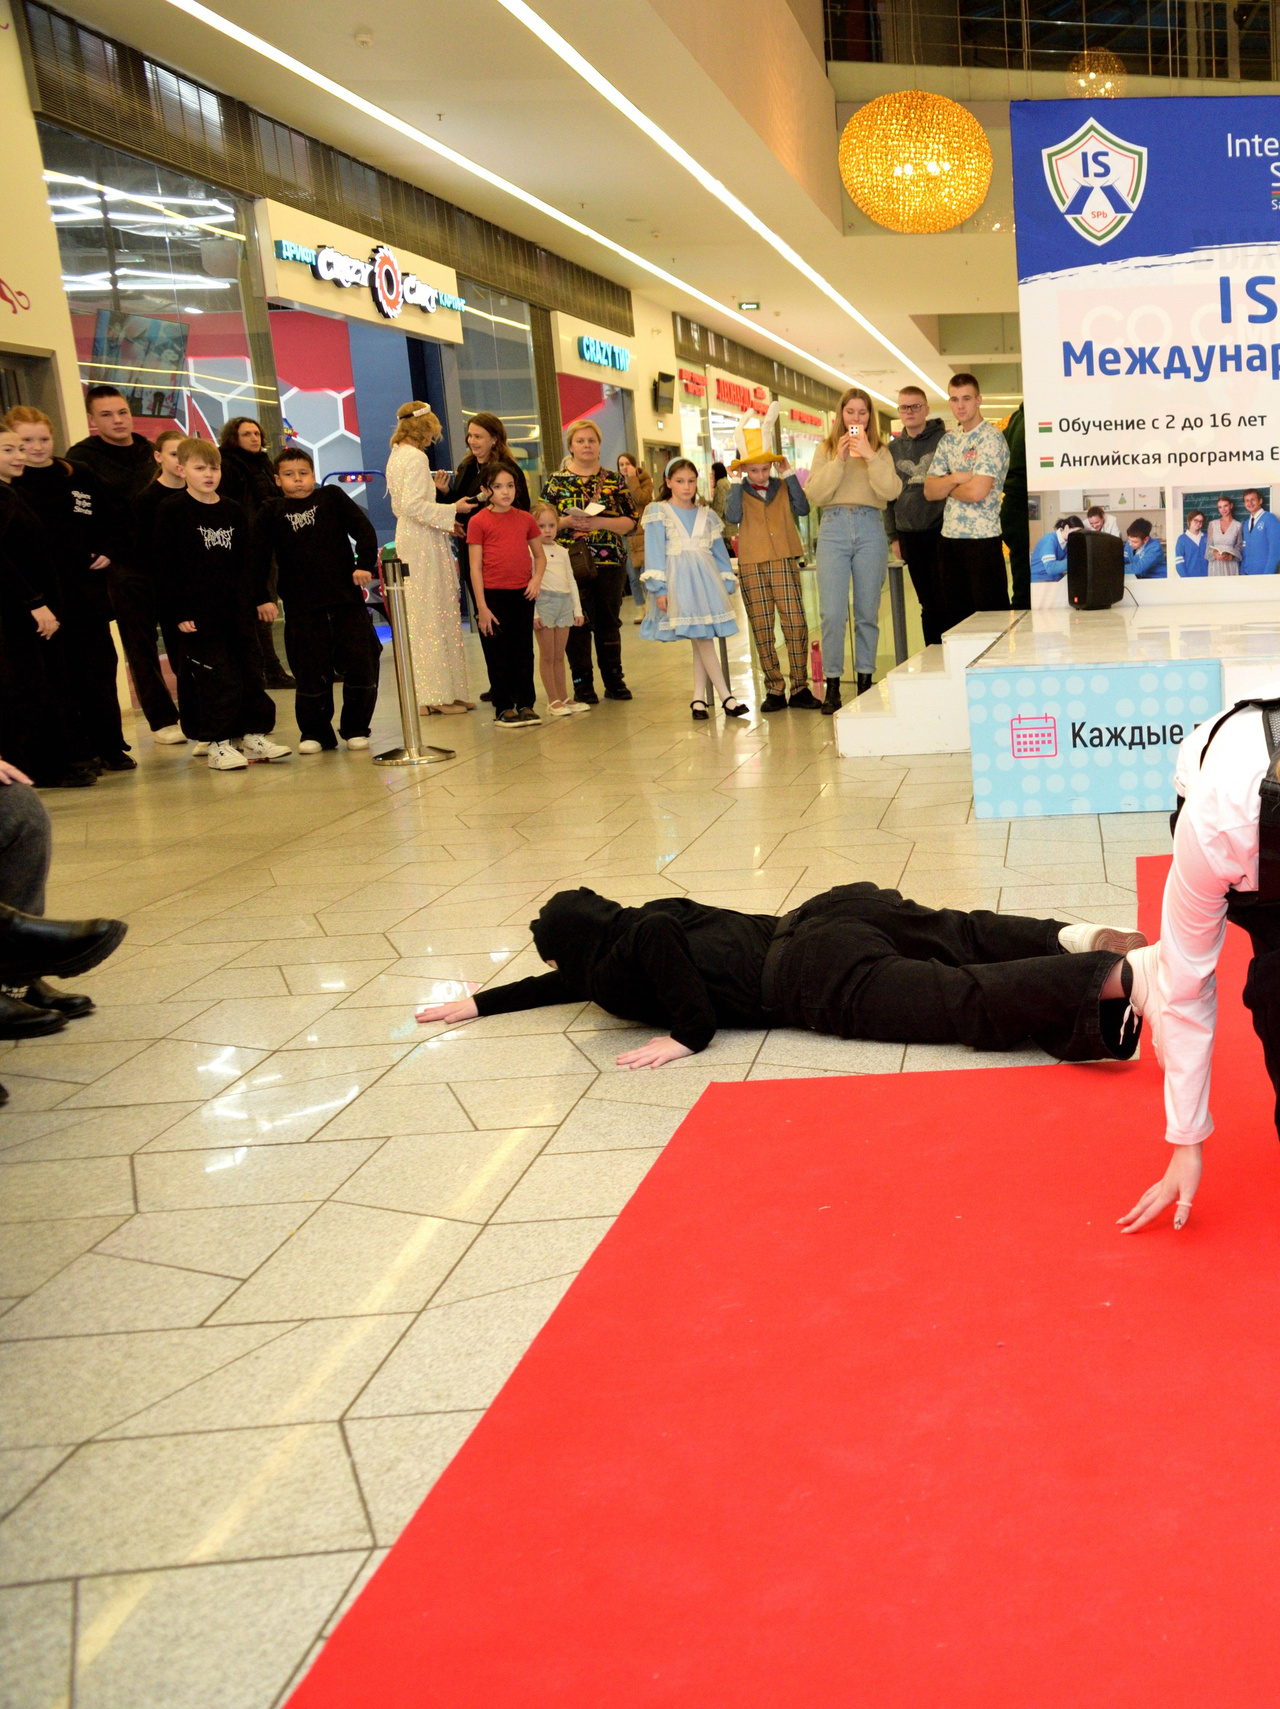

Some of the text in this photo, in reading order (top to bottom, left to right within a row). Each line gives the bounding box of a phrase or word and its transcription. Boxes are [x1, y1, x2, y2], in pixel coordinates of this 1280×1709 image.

[1081, 151, 1111, 178] IS
[1091, 210, 1108, 219] SPb
[582, 335, 631, 372] CRAZY ТИР
[1058, 412, 1267, 435] Обучение с 2 до 16 лет
[1060, 451, 1162, 468] Английская
[1168, 448, 1265, 467] программа
[1070, 721, 1184, 751] Каждые
